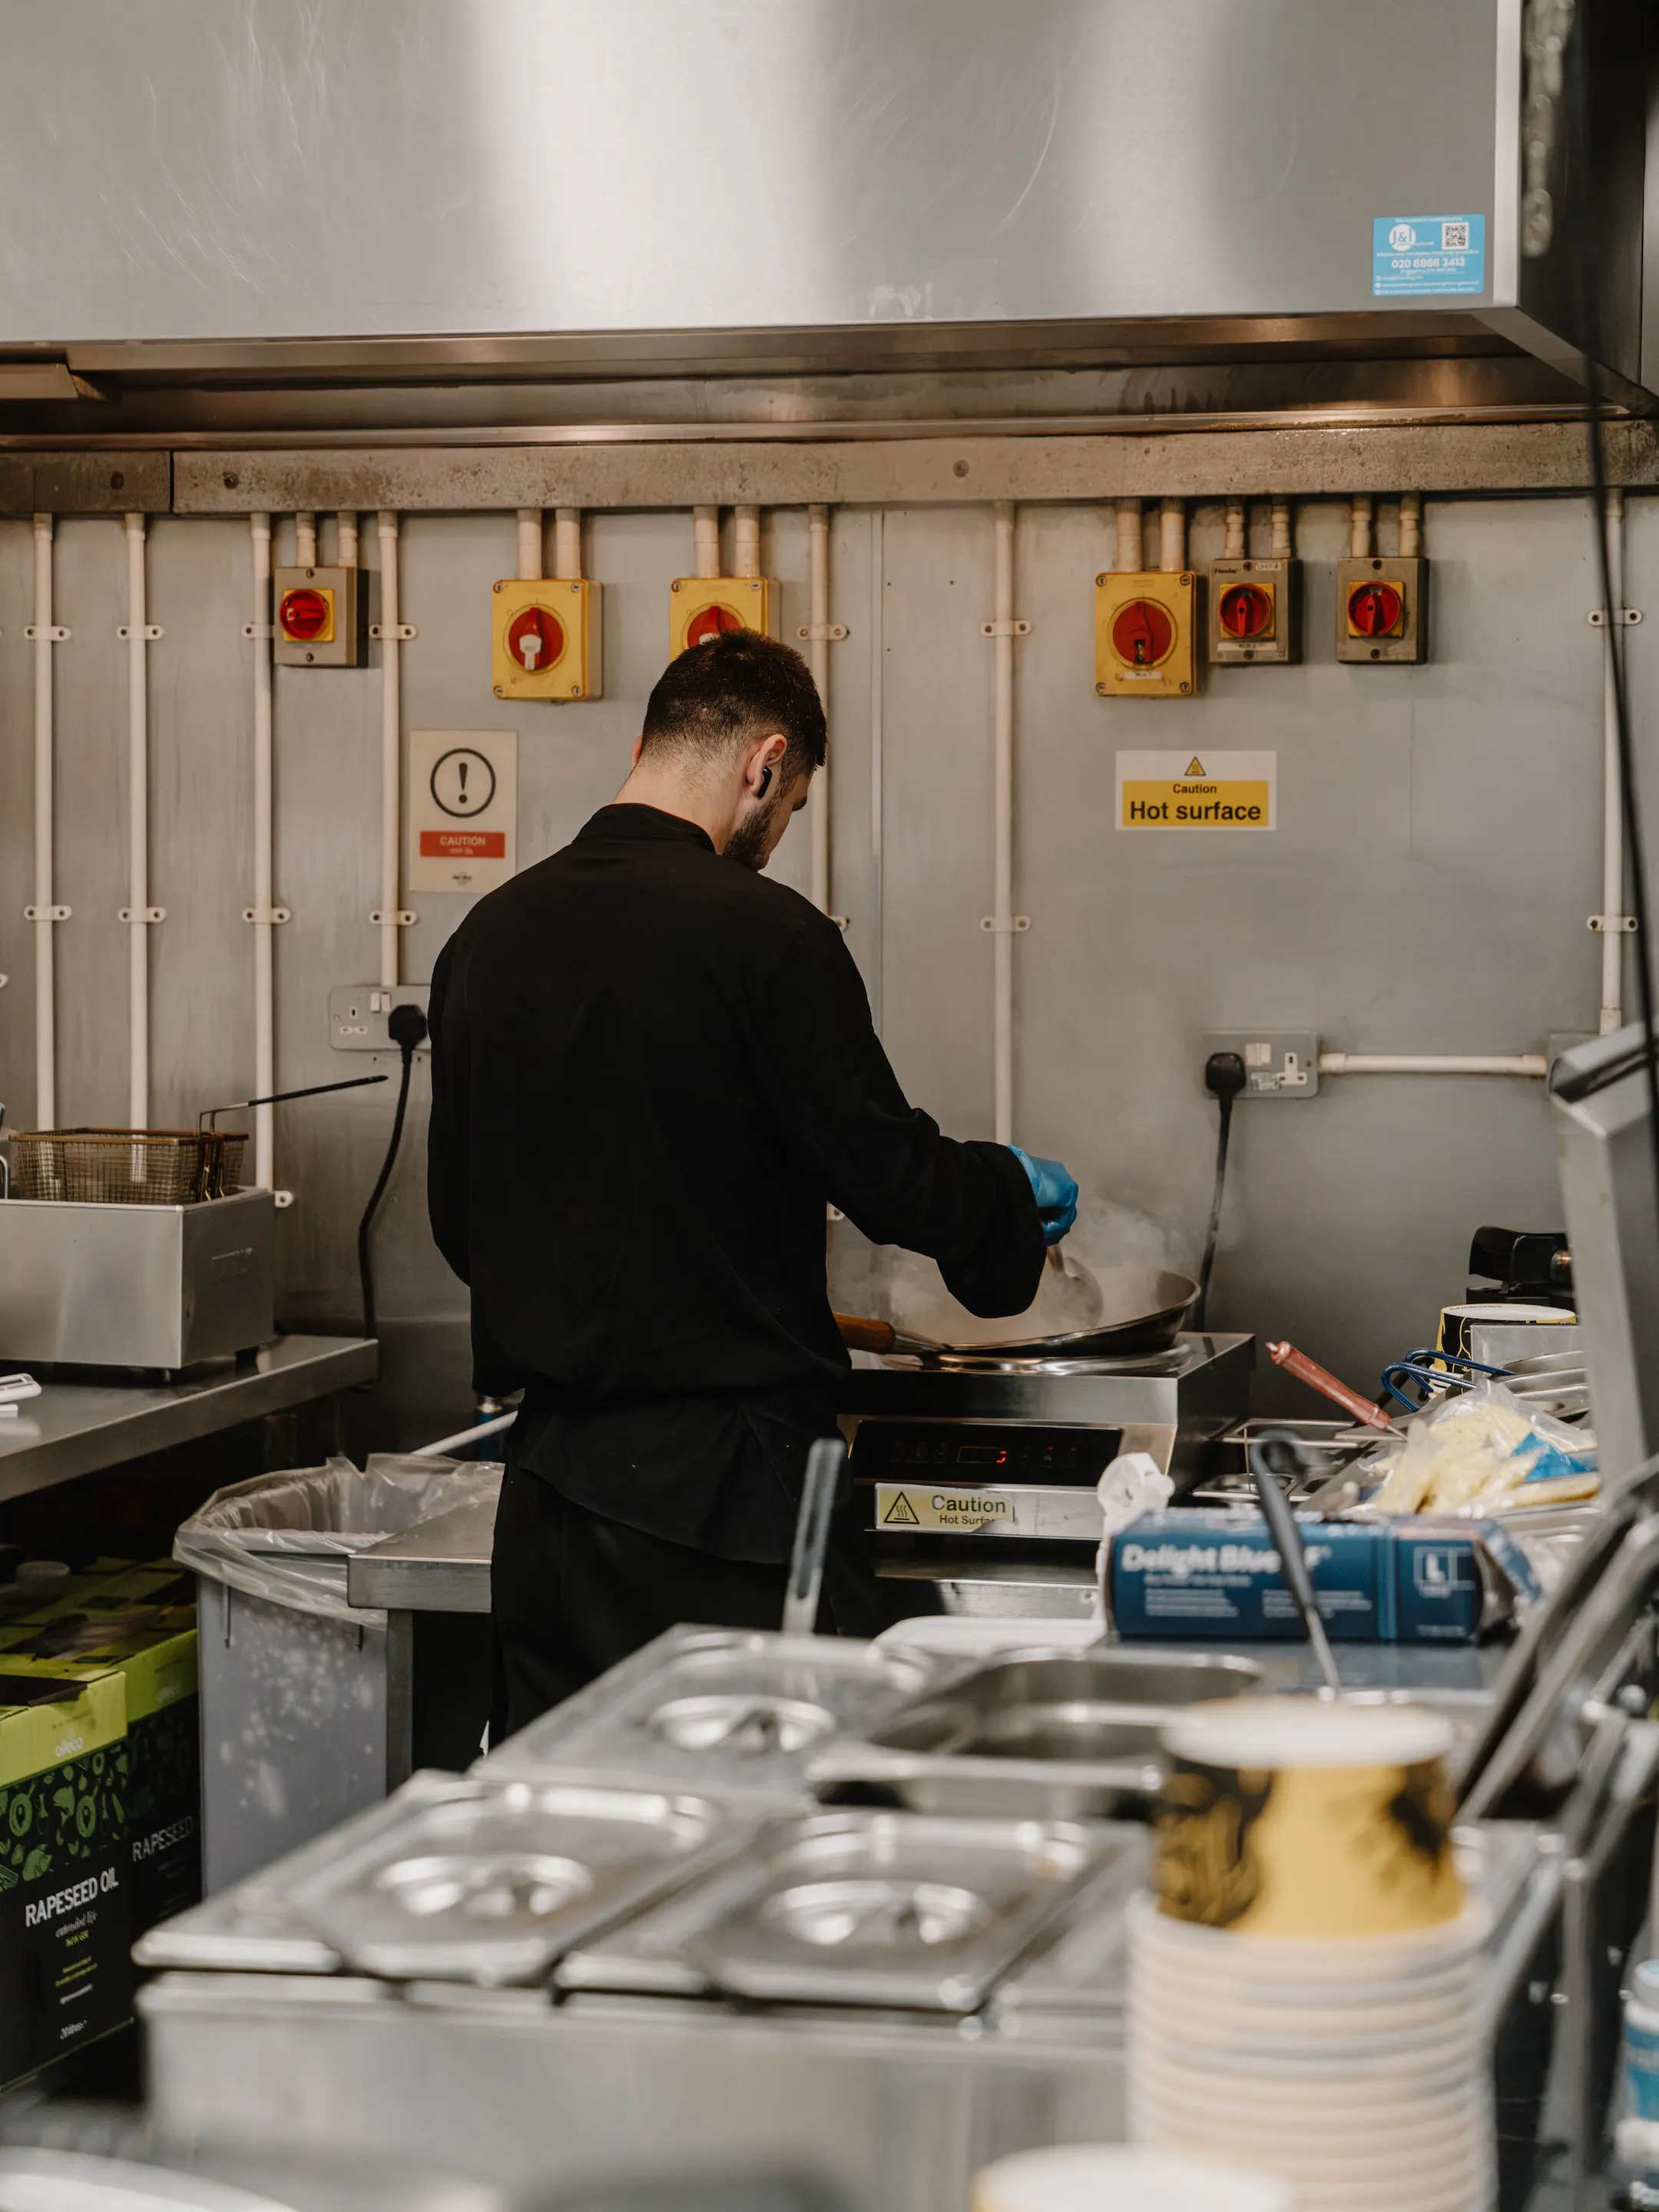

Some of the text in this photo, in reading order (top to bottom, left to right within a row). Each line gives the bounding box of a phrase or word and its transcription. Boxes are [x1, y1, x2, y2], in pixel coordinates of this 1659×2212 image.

[1391, 260, 1411, 268] 020
[1172, 783, 1217, 794] Caution
[1130, 801, 1261, 820] Hot surface
[439, 835, 486, 846] CAUTION
[931, 1494, 1006, 1513] Caution
[939, 1514, 994, 1525] Hot Surf
[1121, 1543, 1217, 1580] Delight
[1219, 1544, 1283, 1574] Blue
[131, 1815, 194, 1863] RAPESEED
[25, 1866, 119, 1928] RAPESEED OIL
